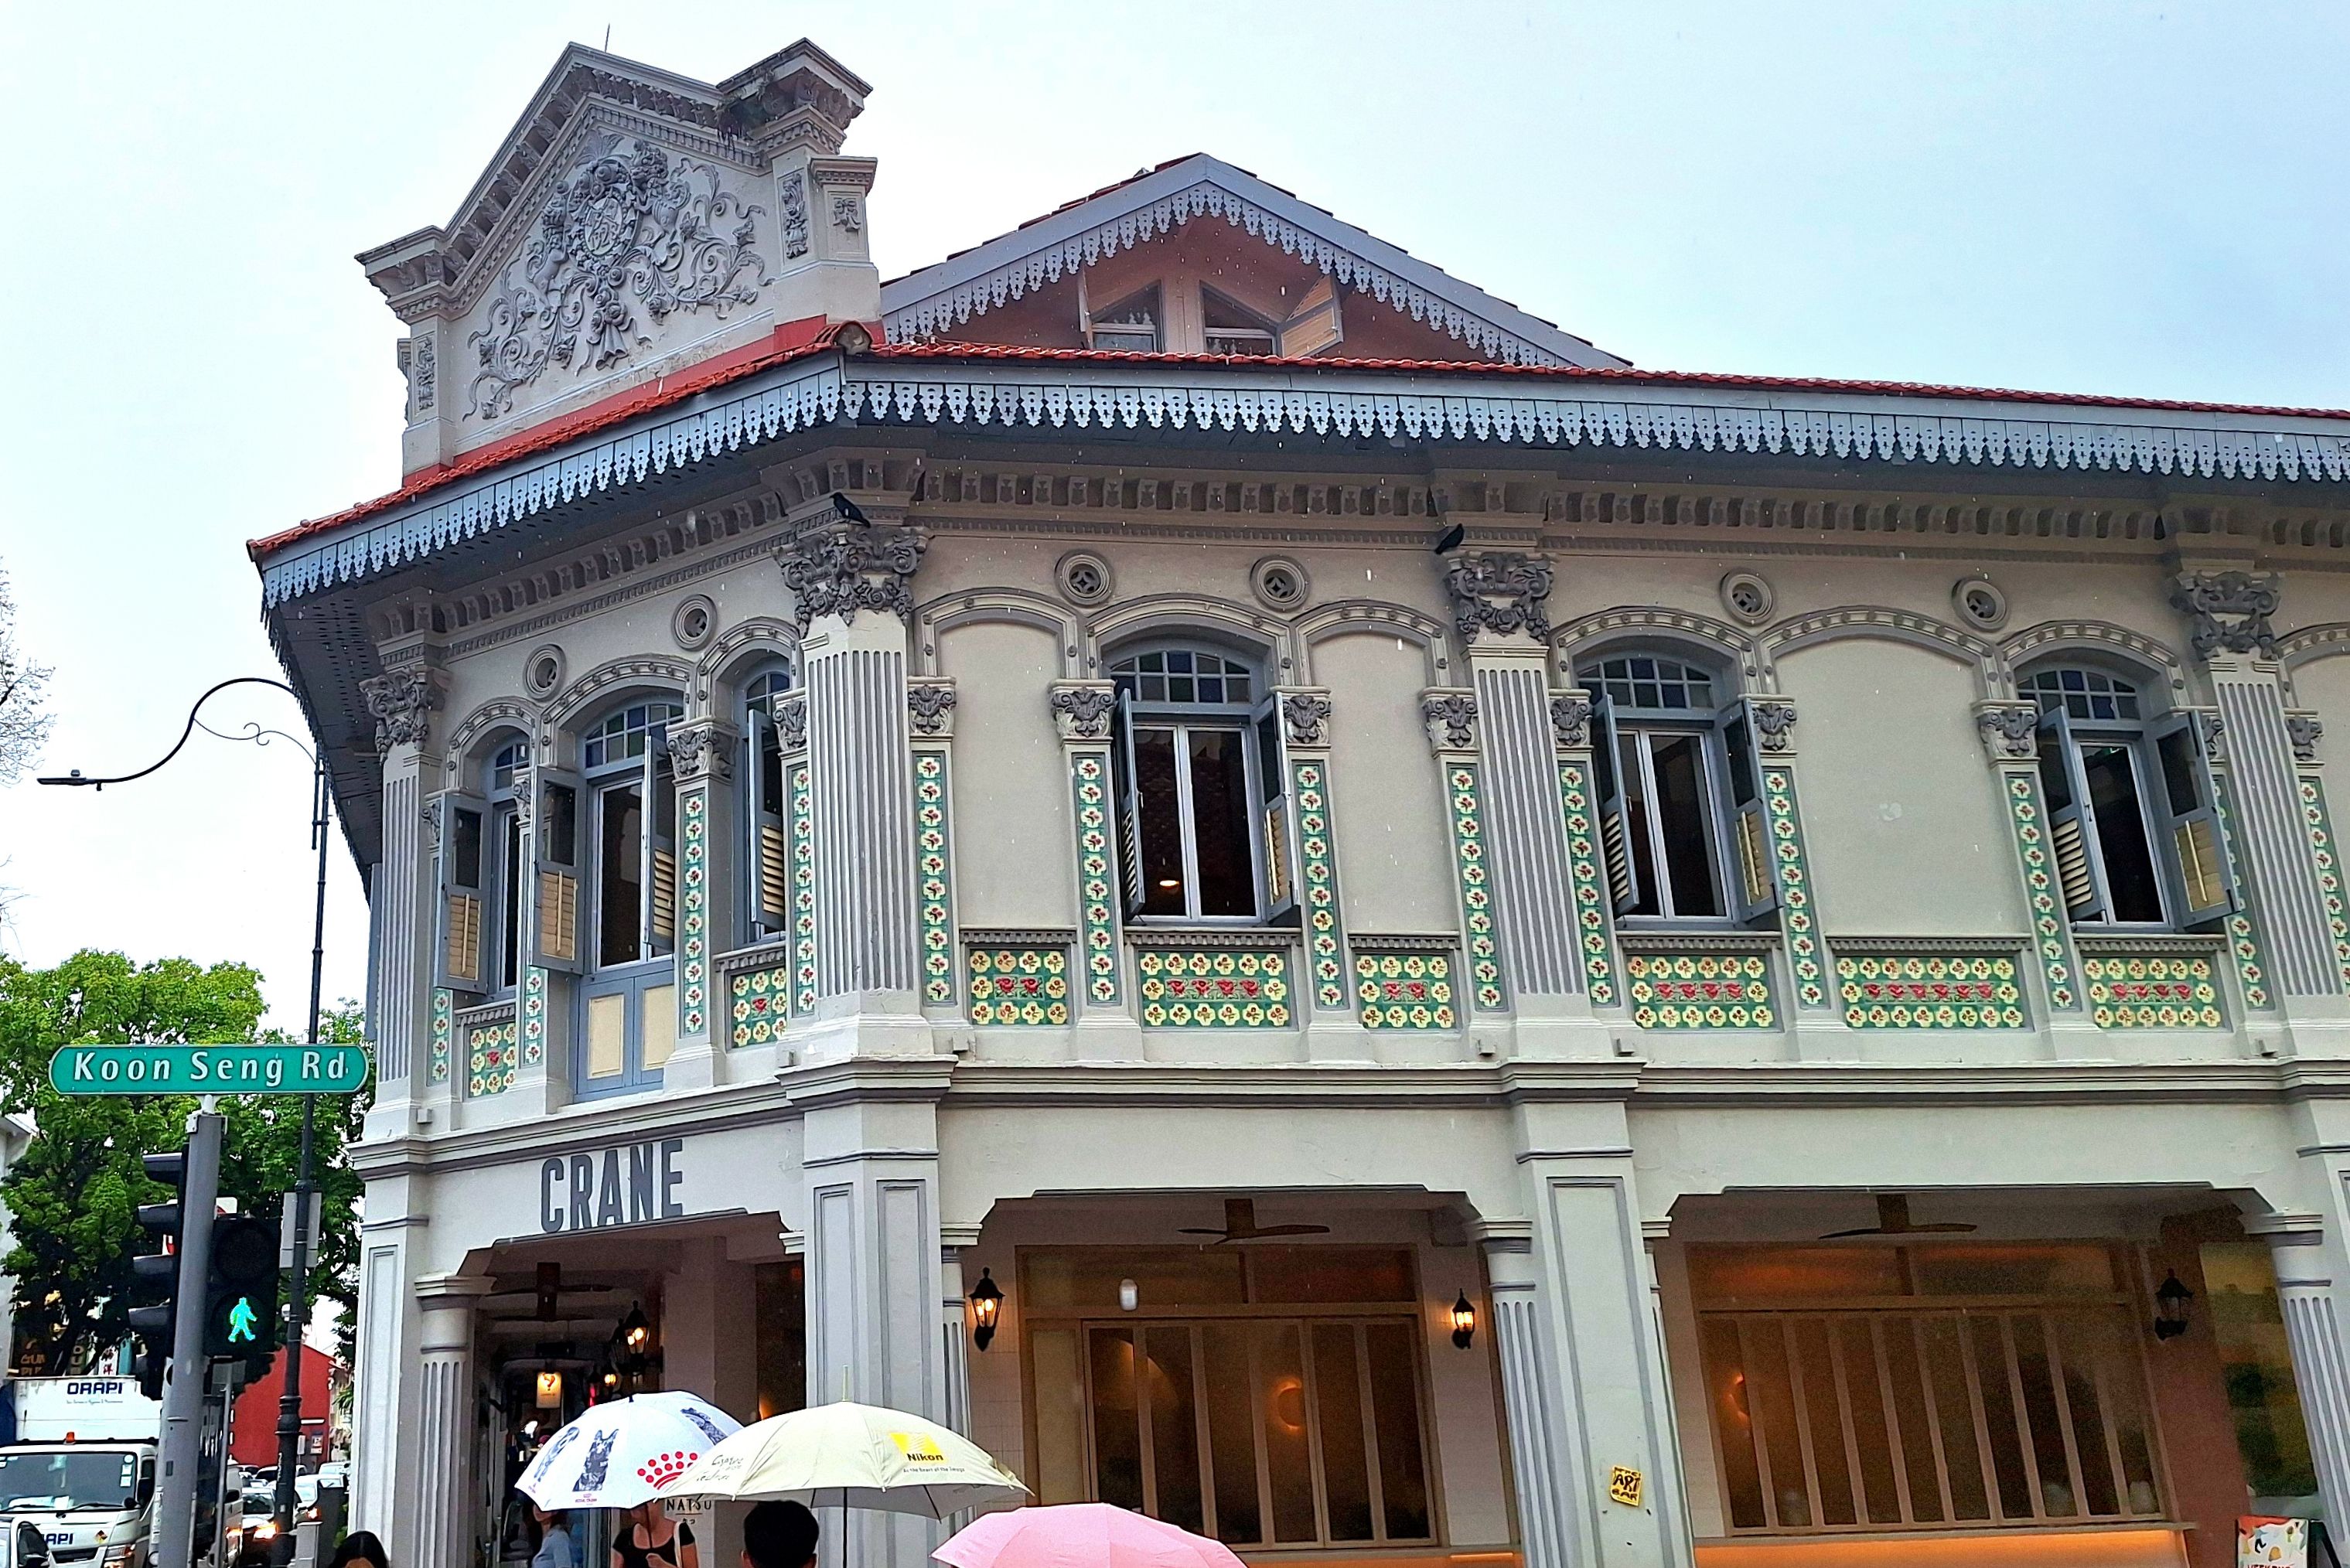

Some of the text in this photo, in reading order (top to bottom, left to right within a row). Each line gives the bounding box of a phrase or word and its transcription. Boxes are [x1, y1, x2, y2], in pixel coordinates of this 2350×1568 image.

[73, 1051, 346, 1087] Koon Seng Rd
[541, 1138, 684, 1233] CRANE
[67, 1382, 123, 1395] ORAPI
[907, 1453, 944, 1461] Nikon
[1612, 1474, 1640, 1492] ART
[666, 1498, 712, 1512] NATSU
[43, 1533, 73, 1545] API
